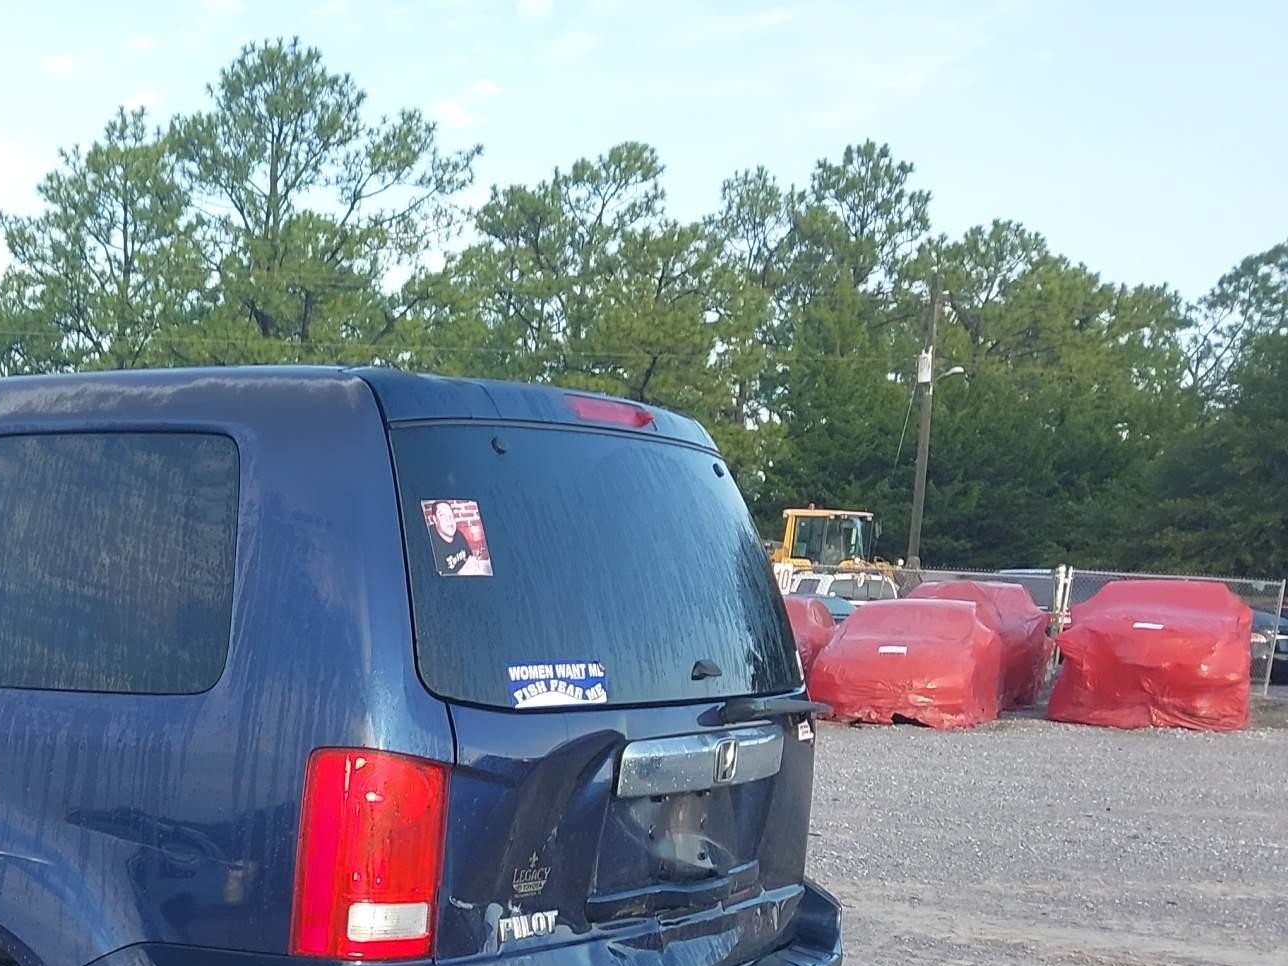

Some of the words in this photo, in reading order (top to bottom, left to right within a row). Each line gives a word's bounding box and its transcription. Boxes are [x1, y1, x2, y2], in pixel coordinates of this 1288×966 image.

[509, 664, 553, 681] WOMEN
[555, 663, 586, 680] WANT
[513, 680, 548, 703] FISH
[550, 680, 583, 700] FEAR
[586, 683, 604, 701] ME
[513, 867, 551, 882] LEGACY
[500, 910, 558, 941] PILOT
